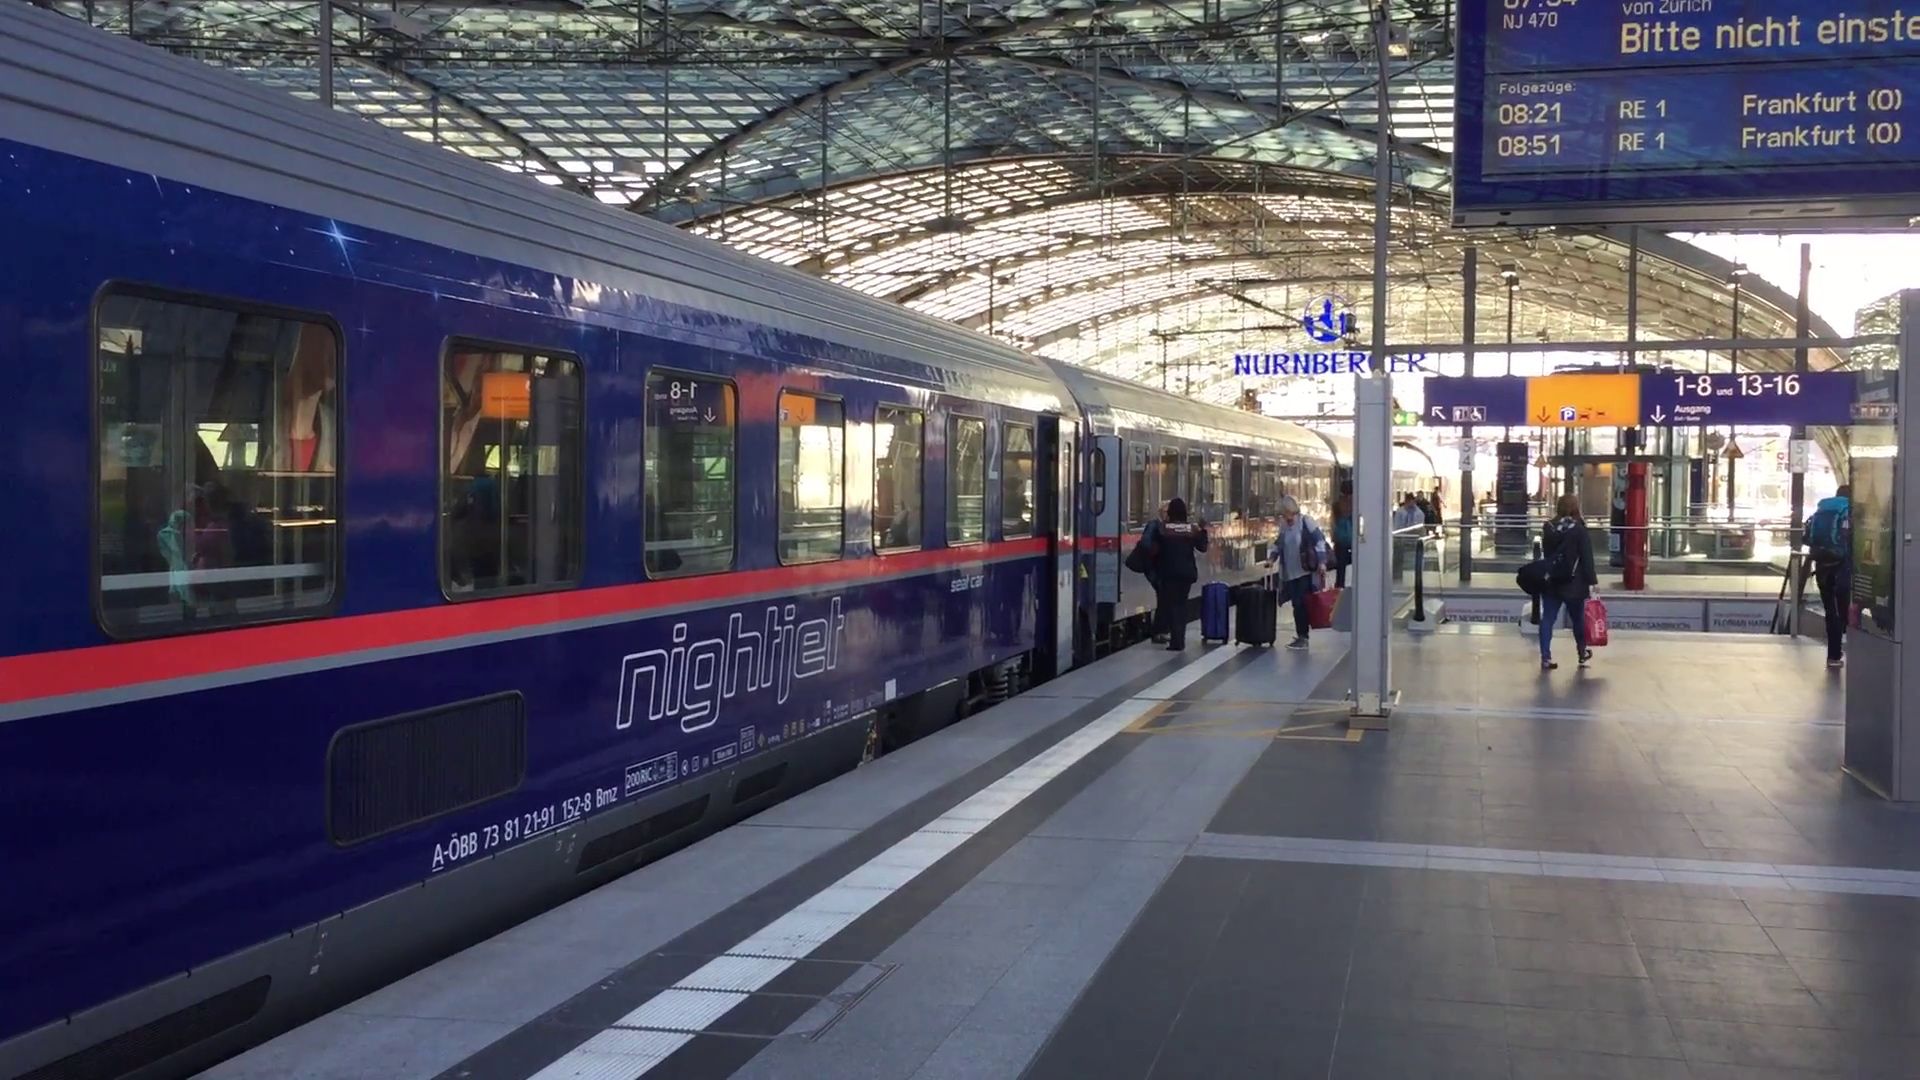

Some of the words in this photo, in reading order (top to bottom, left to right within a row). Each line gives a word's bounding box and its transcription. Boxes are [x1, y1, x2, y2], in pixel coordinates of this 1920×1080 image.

[1622, 1, 1654, 15] von
[1503, 14, 1524, 29] NJ
[1528, 11, 1558, 28] 470
[1620, 21, 1700, 53] Bitte
[1716, 15, 1801, 49] nicht
[1499, 81, 1577, 97] Folgezüge:
[1499, 102, 1562, 125] 08:21
[1618, 100, 1646, 119] RE
[1656, 100, 1666, 118] 1
[1742, 91, 1857, 116] Frankfurt
[1498, 134, 1561, 156] 08:51
[1617, 133, 1645, 151] RE
[1655, 132, 1665, 150] 1
[1741, 124, 1856, 148] Frankfurt
[1234, 352, 1427, 375] NÜRNBERER
[1674, 375, 1712, 396] 1-8
[1716, 387, 1733, 396] und
[1737, 374, 1800, 396] 13-16
[1674, 404, 1711, 414] Ausgang
[616, 596, 844, 733] nightjet
[432, 831, 478, 872] A-ÖBB
[483, 824, 500, 850] 73
[504, 816, 520, 842] 81
[523, 805, 556, 836] 21-91
[562, 793, 592, 821] 152-8
[596, 786, 619, 809] Bmz
